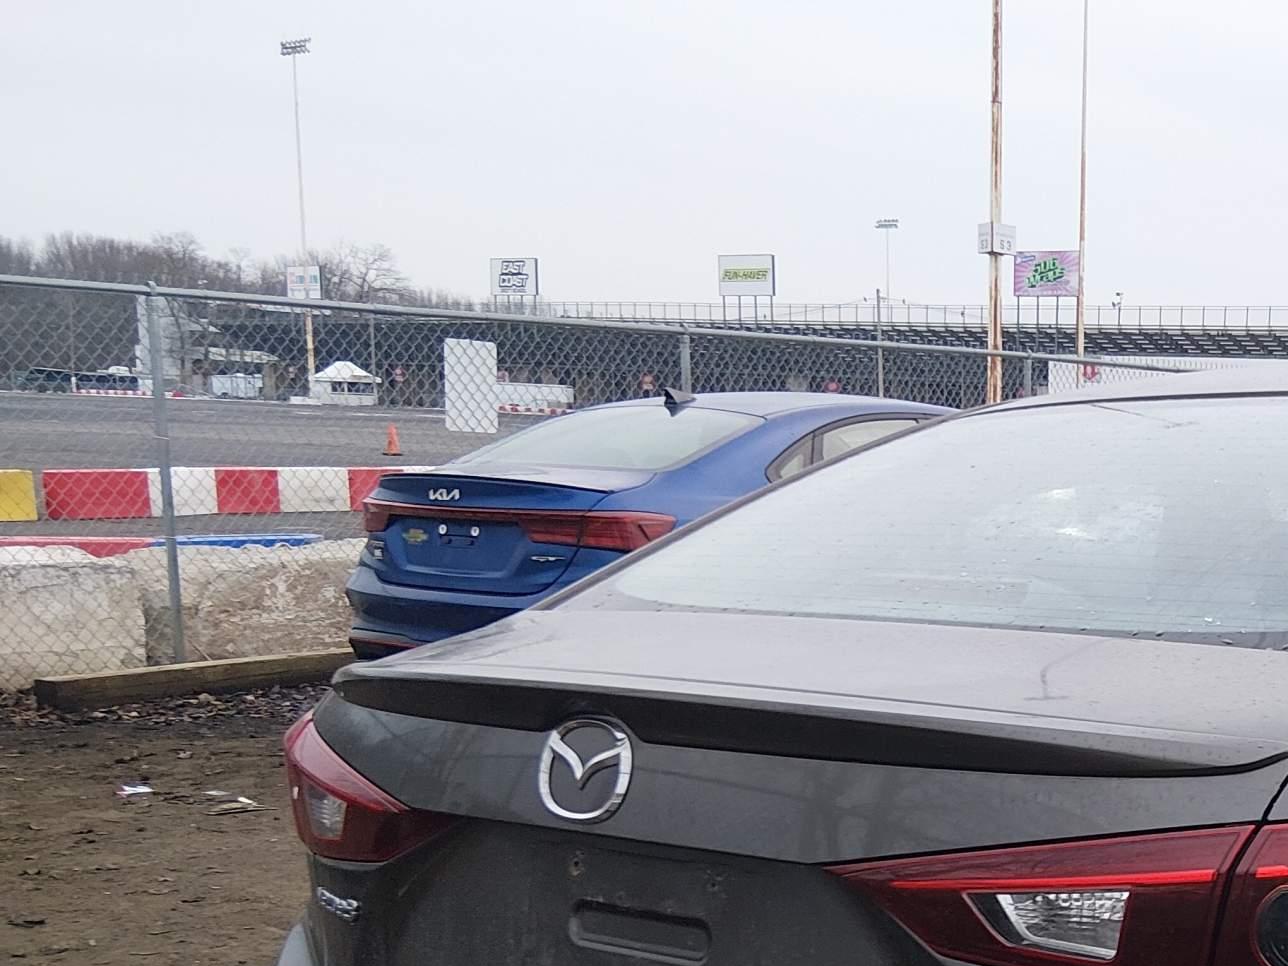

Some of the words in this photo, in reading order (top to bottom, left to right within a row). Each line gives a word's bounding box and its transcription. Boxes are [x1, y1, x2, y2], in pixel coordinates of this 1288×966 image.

[501, 260, 525, 274] EAST
[498, 274, 528, 288] COAST
[428, 488, 461, 501] KIA
